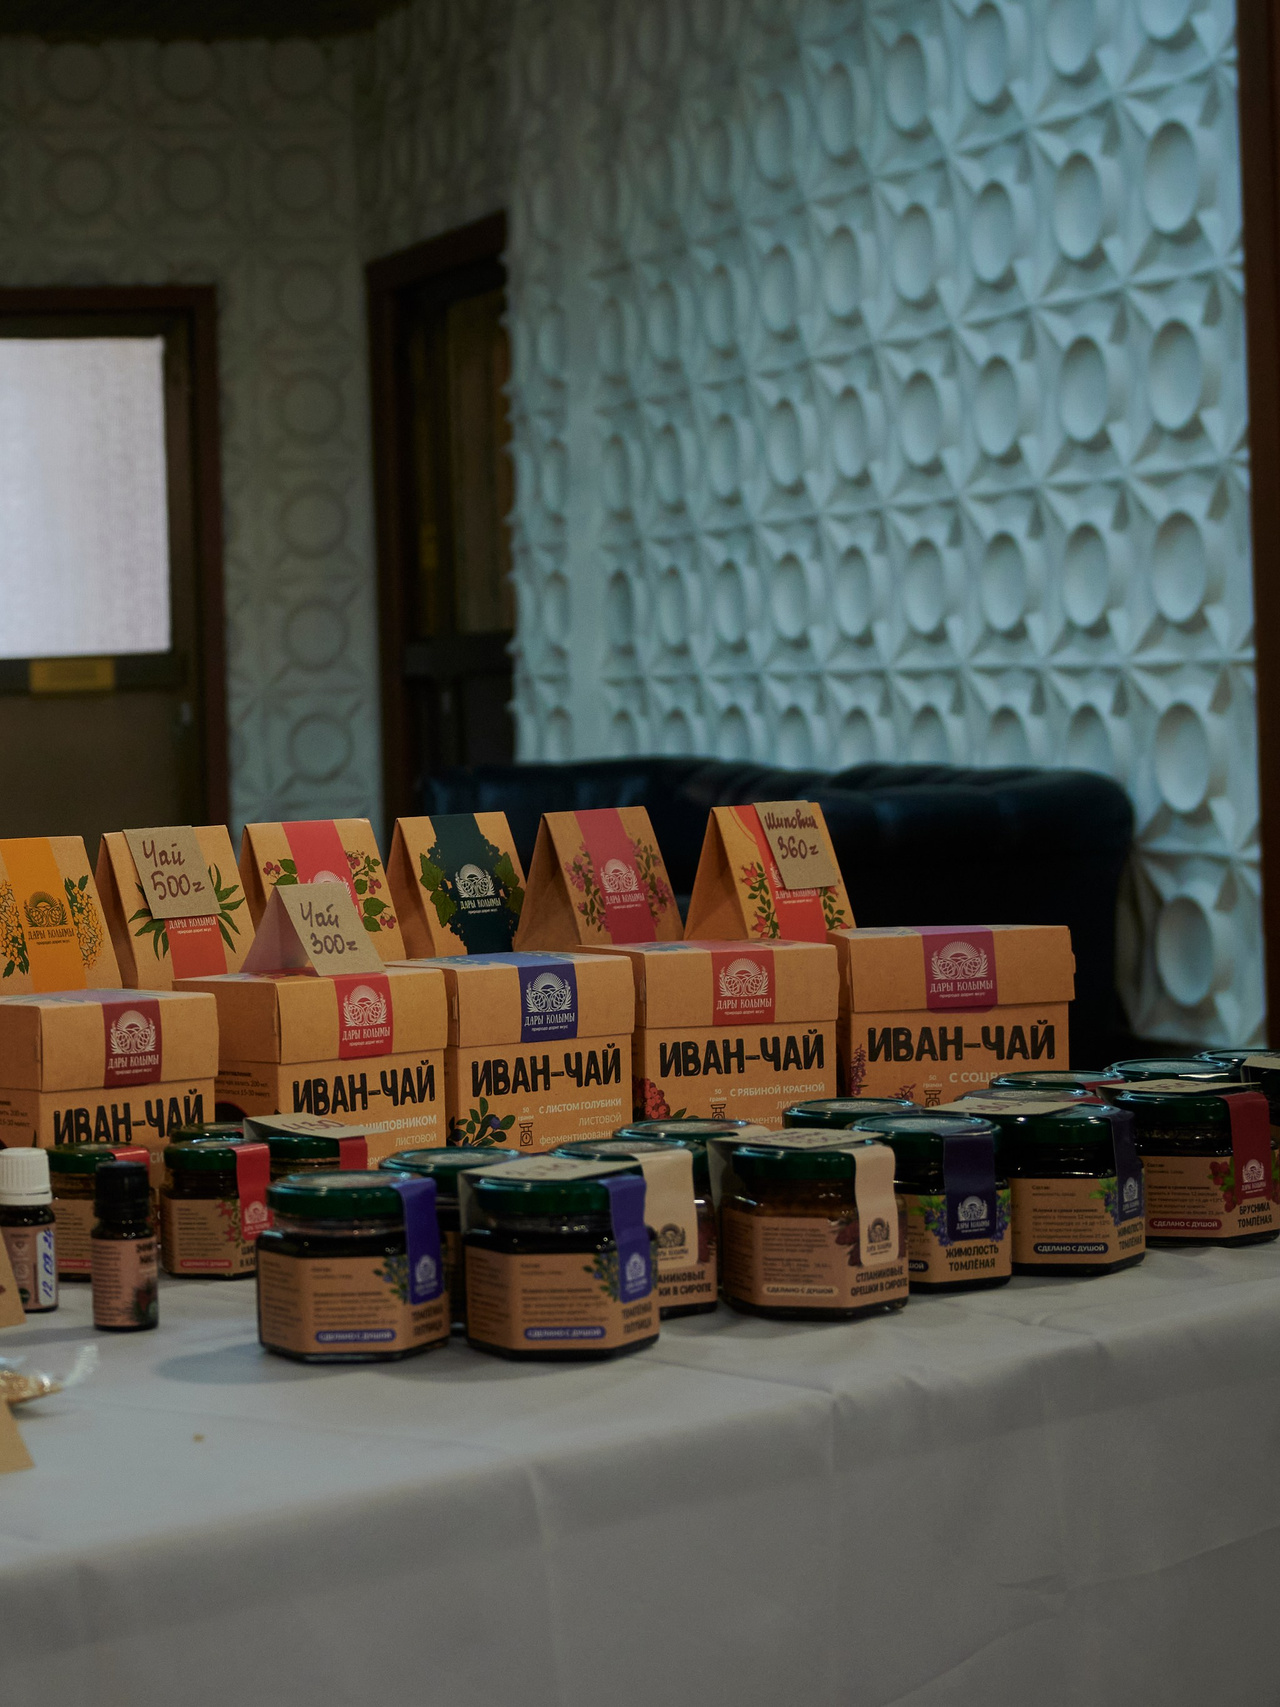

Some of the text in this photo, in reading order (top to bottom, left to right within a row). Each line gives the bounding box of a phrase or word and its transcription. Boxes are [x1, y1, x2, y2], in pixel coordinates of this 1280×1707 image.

[142, 839, 186, 873] Чай
[299, 901, 340, 928] Чай
[930, 979, 994, 994] ДАРЫ КОЛЫМЫ
[716, 997, 773, 1011] ДАРЫ КОЛЫМЫ
[524, 1011, 576, 1027] ДАРЫ КОЛЫМЫ
[342, 1031, 361, 1042] ДАРЫ
[867, 1019, 1056, 1063] ИВАН-ЧАЙ
[659, 1028, 826, 1078] ИВАН-ЧАЙ
[470, 1043, 622, 1098] ИВАН-ЧАЙ
[292, 1059, 436, 1117] ИВАН-ЧАЙ
[730, 1081, 826, 1098] С РЯБИНОЙ КРАСНОЙ
[538, 1097, 622, 1114] С ЛИСТОМ ГОЛУБИКИ
[53, 1088, 204, 1147] ИВАН-ЧАЙ
[578, 1112, 623, 1127] ЛИСТОВОЙ
[395, 1131, 438, 1148] ЛИСТОВОЙ
[1239, 1202, 1271, 1216] БРУСНИКА
[1153, 1220, 1186, 1230] СДЕЛАНО
[1191, 1220, 1219, 1229] ДУШОЙ
[945, 1244, 999, 1258] ЖИМОЛОСТЬ
[658, 1270, 705, 1284] АНИКОВЫЕ
[855, 1265, 904, 1283] СТЛАНИКОВЫЕ
[850, 1282, 879, 1297] ОРЕШКИ
[885, 1277, 908, 1291] СИРОПЕ
